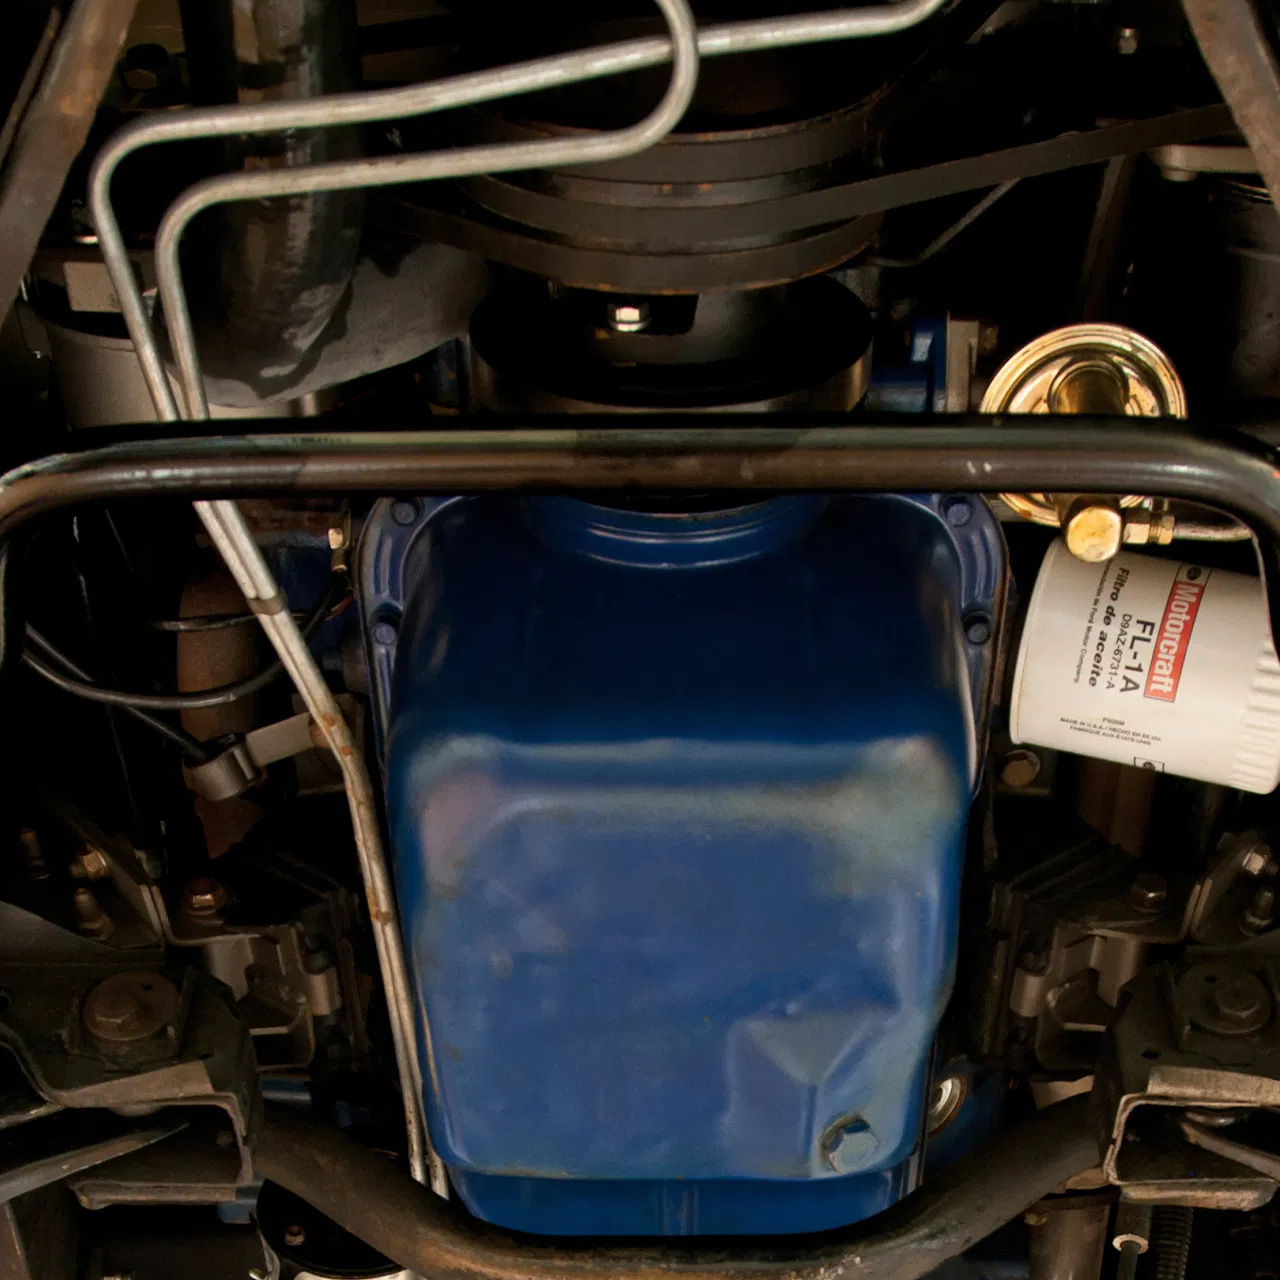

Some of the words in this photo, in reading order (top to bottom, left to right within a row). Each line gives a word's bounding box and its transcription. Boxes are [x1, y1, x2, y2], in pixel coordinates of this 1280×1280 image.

[1103, 605, 1116, 626] de
[1110, 567, 1130, 601] Filtro
[1088, 630, 1108, 687] aceite
[1105, 613, 1132, 690] D9AZ-6731-A
[1120, 618, 1156, 693] FL-1A
[1150, 582, 1200, 693] Motorcraft
